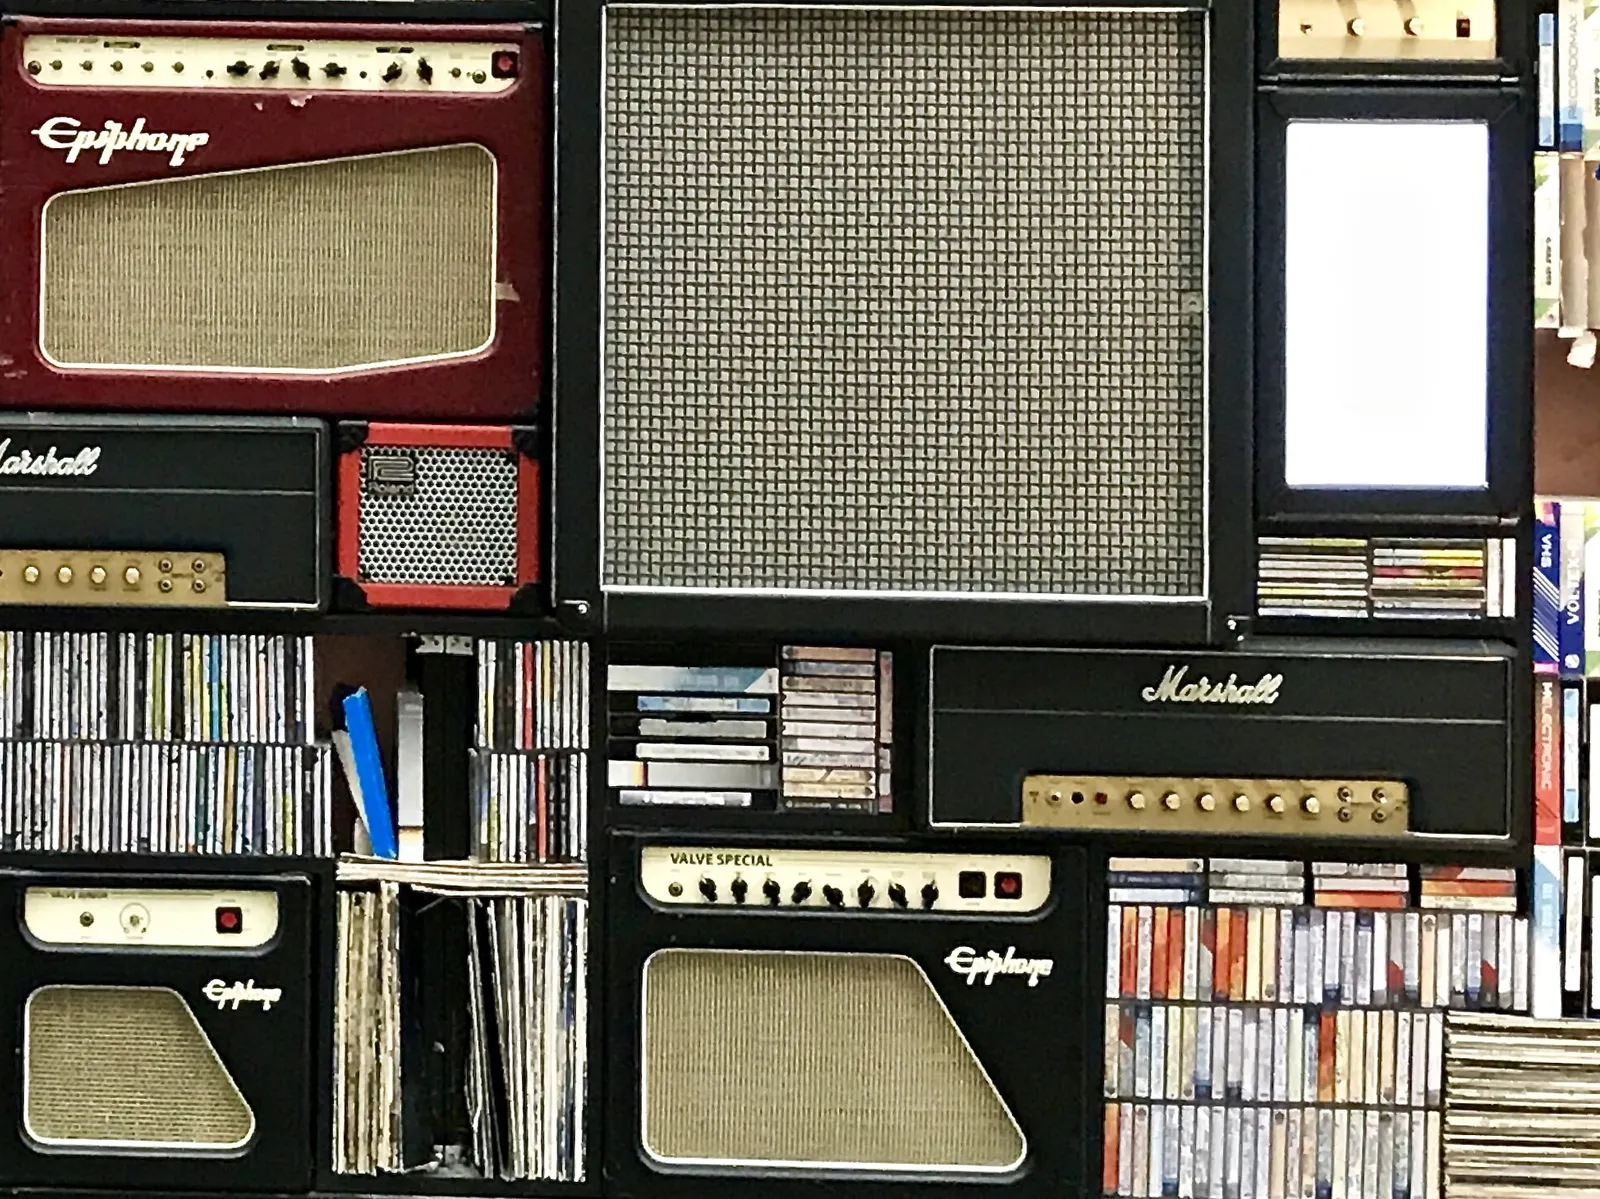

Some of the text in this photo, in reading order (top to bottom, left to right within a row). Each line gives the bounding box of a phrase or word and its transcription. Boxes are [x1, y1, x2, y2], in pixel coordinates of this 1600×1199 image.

[31, 116, 210, 167] Epiphone
[1541, 533, 1552, 568] VHS
[1142, 665, 1285, 705] Marshall
[670, 852, 774, 868] VALVE SPECIAL
[943, 945, 1054, 987] Epiphone
